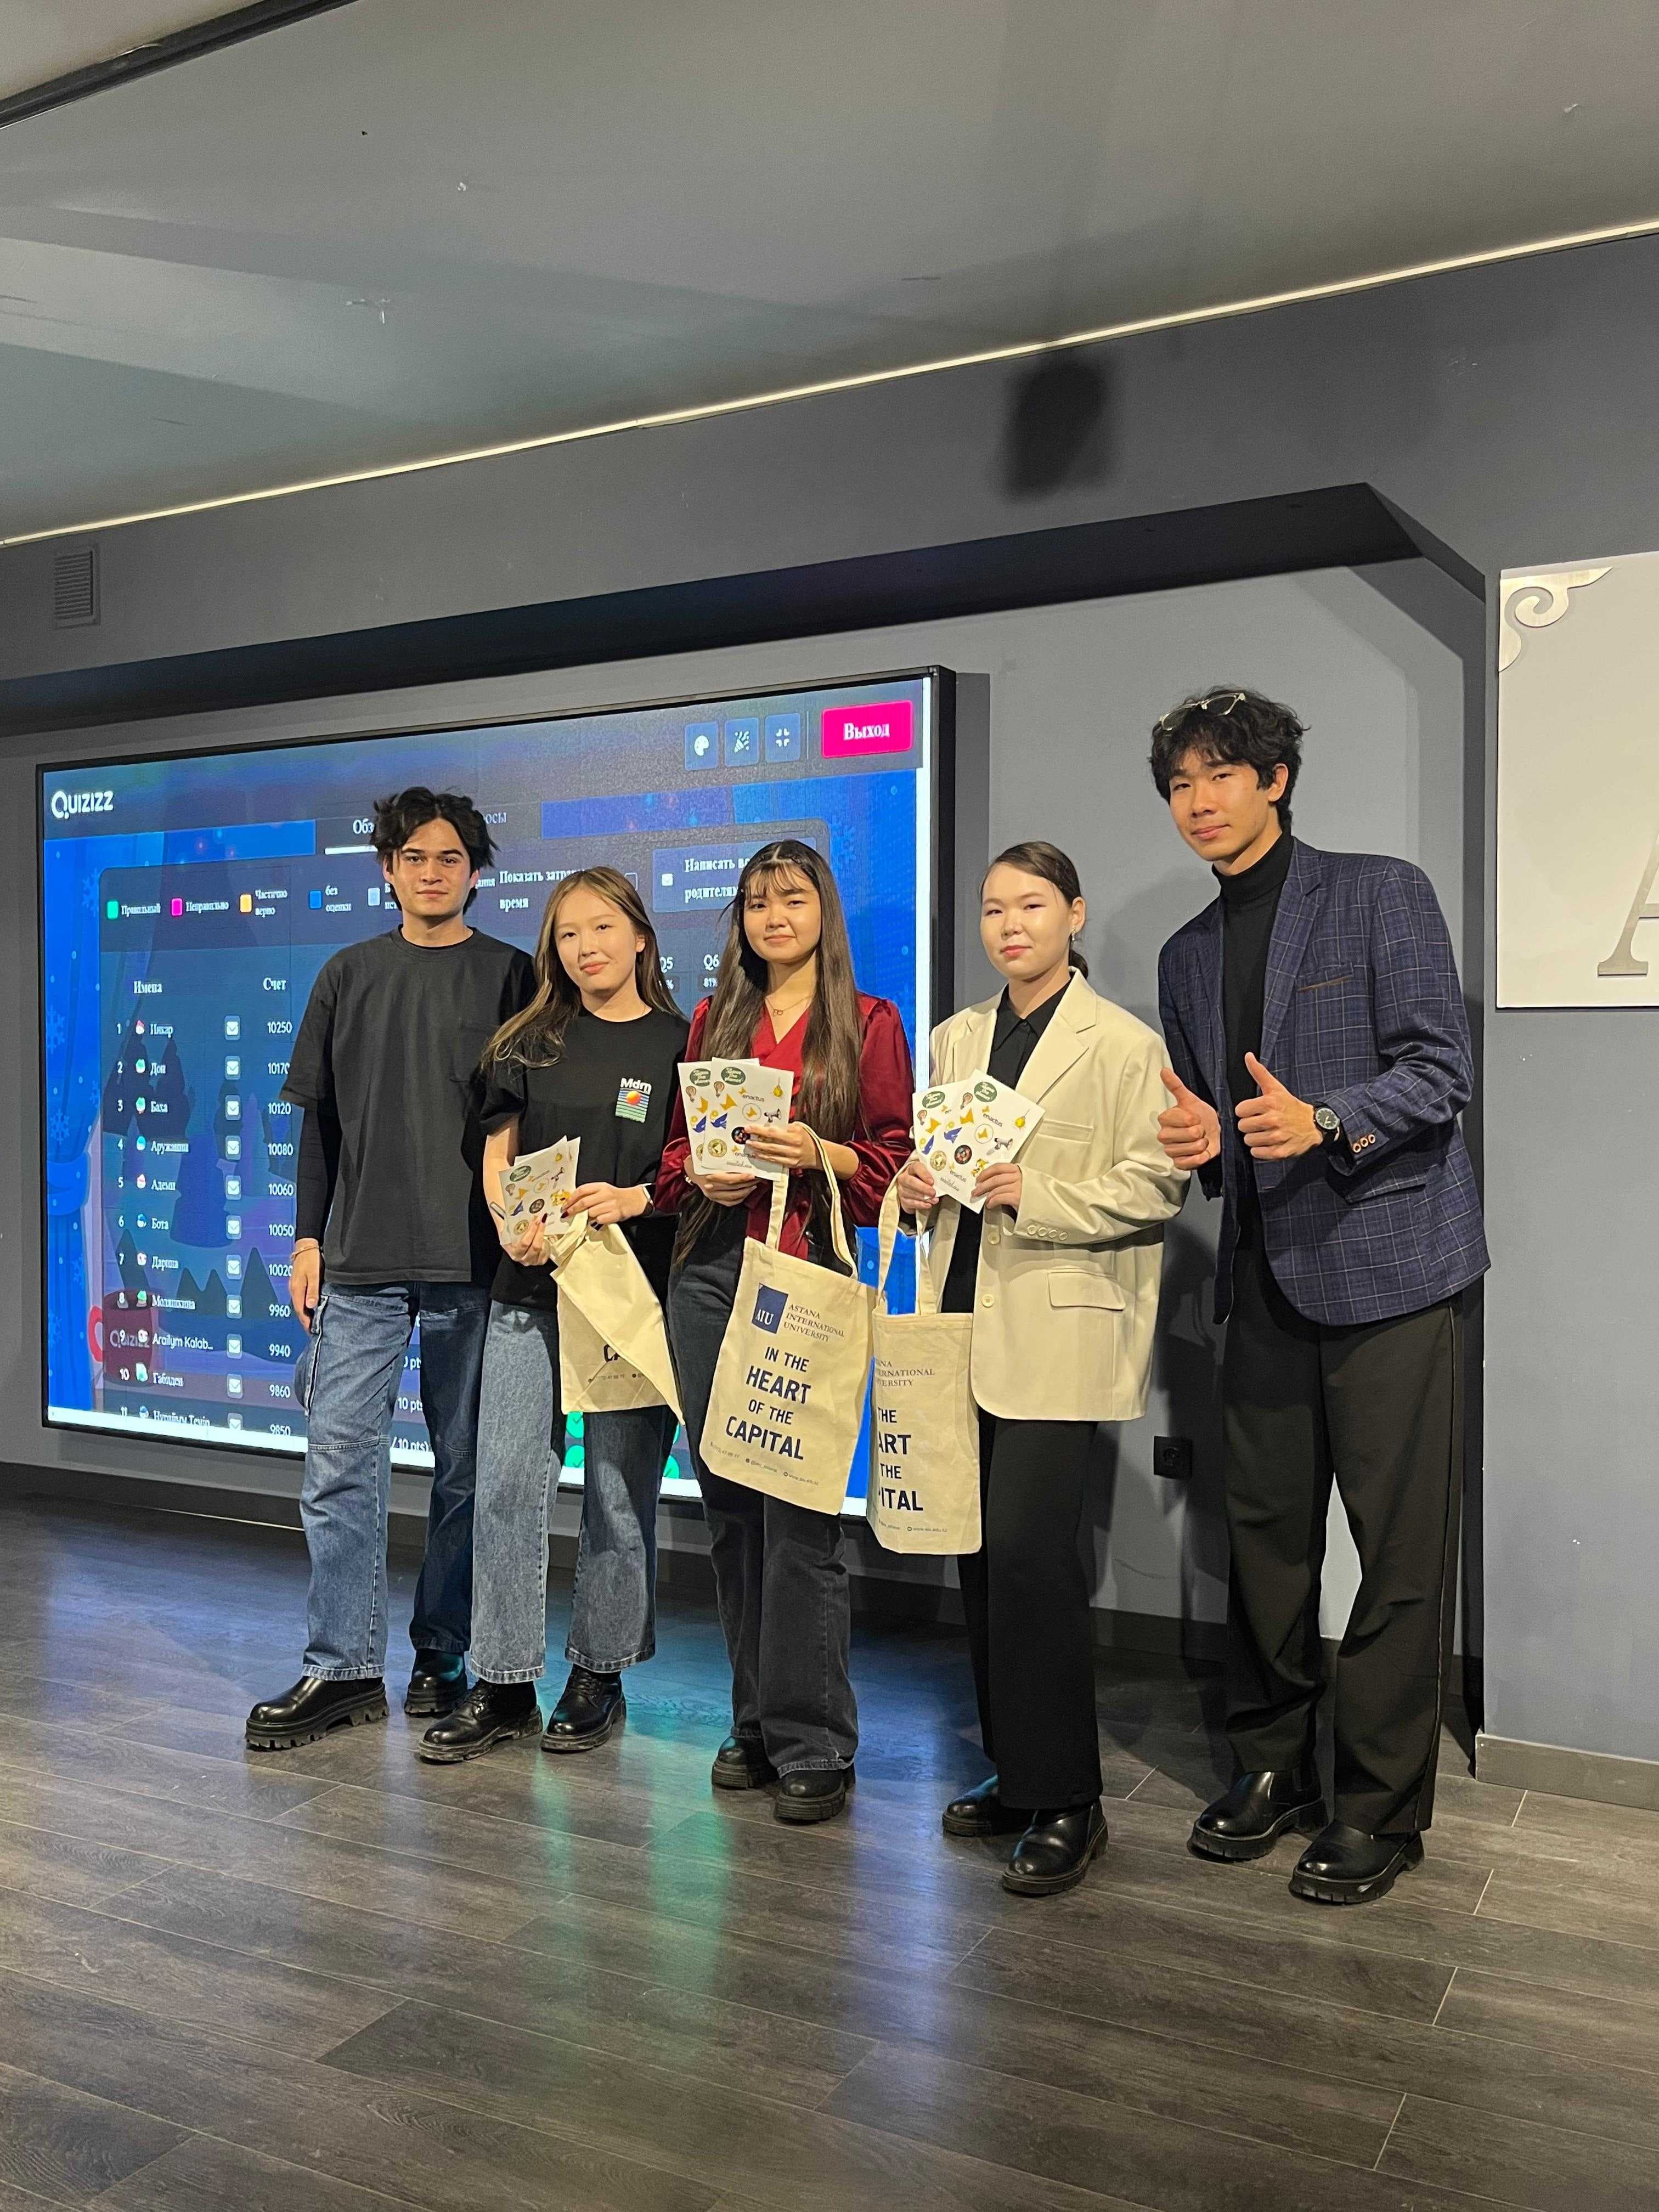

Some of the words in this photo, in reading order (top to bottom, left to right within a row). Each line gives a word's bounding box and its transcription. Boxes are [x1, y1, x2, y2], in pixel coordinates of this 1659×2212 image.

[843, 723, 890, 741] Выход
[685, 858, 735, 873] Написать
[500, 870, 543, 884] Показать
[500, 898, 529, 912] время
[703, 954, 720, 970] Q6
[134, 981, 162, 994] Имена
[263, 977, 286, 990] Счет
[268, 1021, 292, 1034] 10250
[268, 1102, 291, 1115] 10120
[268, 1143, 294, 1155] 10080
[268, 1183, 294, 1196] 10060
[269, 1224, 294, 1237] 10050
[269, 1304, 291, 1317] 9960
[755, 1309, 774, 1325] AIU
[788, 1304, 820, 1319] ASTANA
[783, 1322, 830, 1342] UNIVERSITY
[786, 1313, 844, 1338] INTERNATIONAL
[269, 1344, 291, 1357] 9940
[764, 1346, 779, 1362] IN
[785, 1352, 809, 1373] THE
[269, 1384, 291, 1398] 9860
[746, 1365, 811, 1404] HEART
[748, 1399, 765, 1414] OF
[770, 1406, 794, 1425] THE
[726, 1416, 804, 1460] CAPITAL
[880, 1463, 902, 1479] THE
[879, 1486, 923, 1511] ITAL
